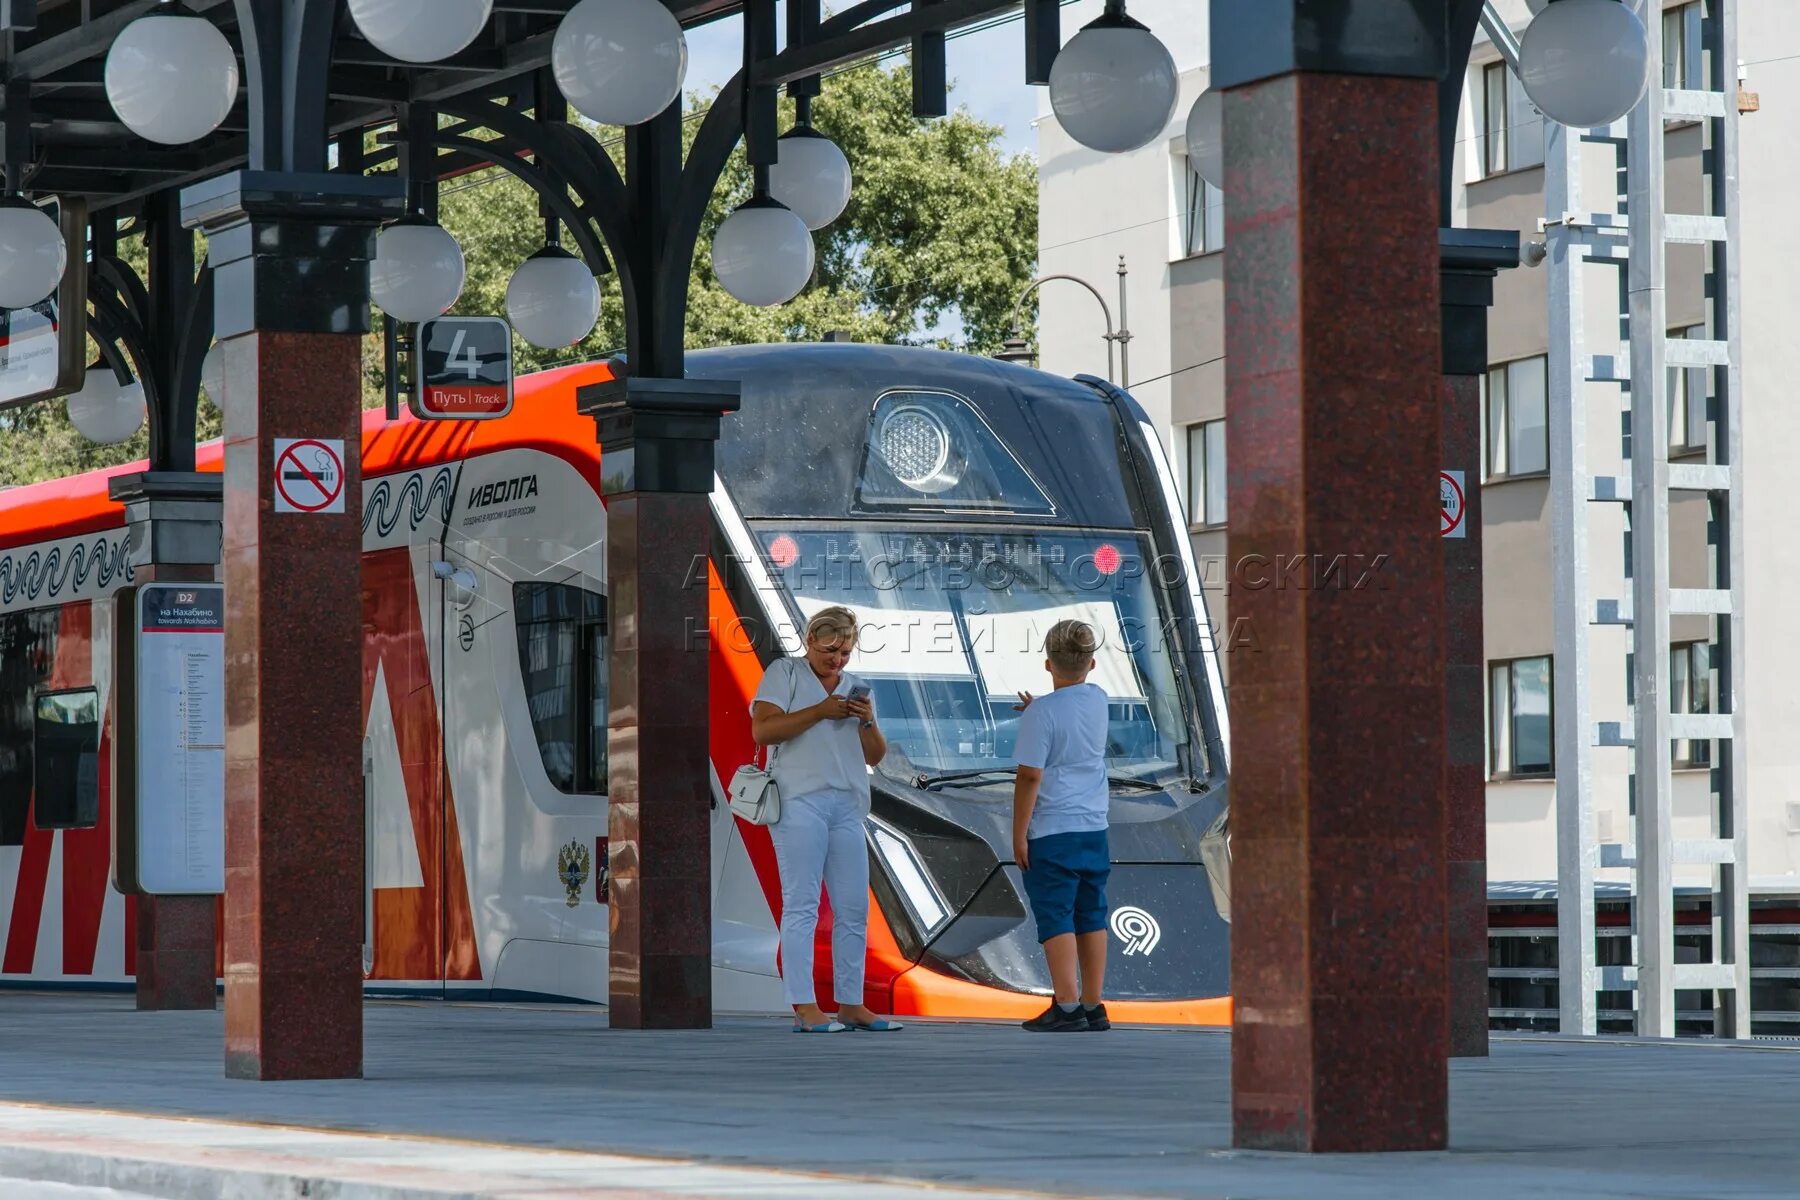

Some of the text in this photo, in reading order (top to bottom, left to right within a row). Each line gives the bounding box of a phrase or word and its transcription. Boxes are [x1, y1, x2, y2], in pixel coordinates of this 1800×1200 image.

[445, 329, 483, 379] 4
[433, 391, 500, 406] Путь Track
[467, 474, 538, 509] ИВОЛГА
[889, 539, 1065, 565] НАХАБИНО
[179, 593, 193, 602] D2
[172, 608, 213, 616] Нахабино
